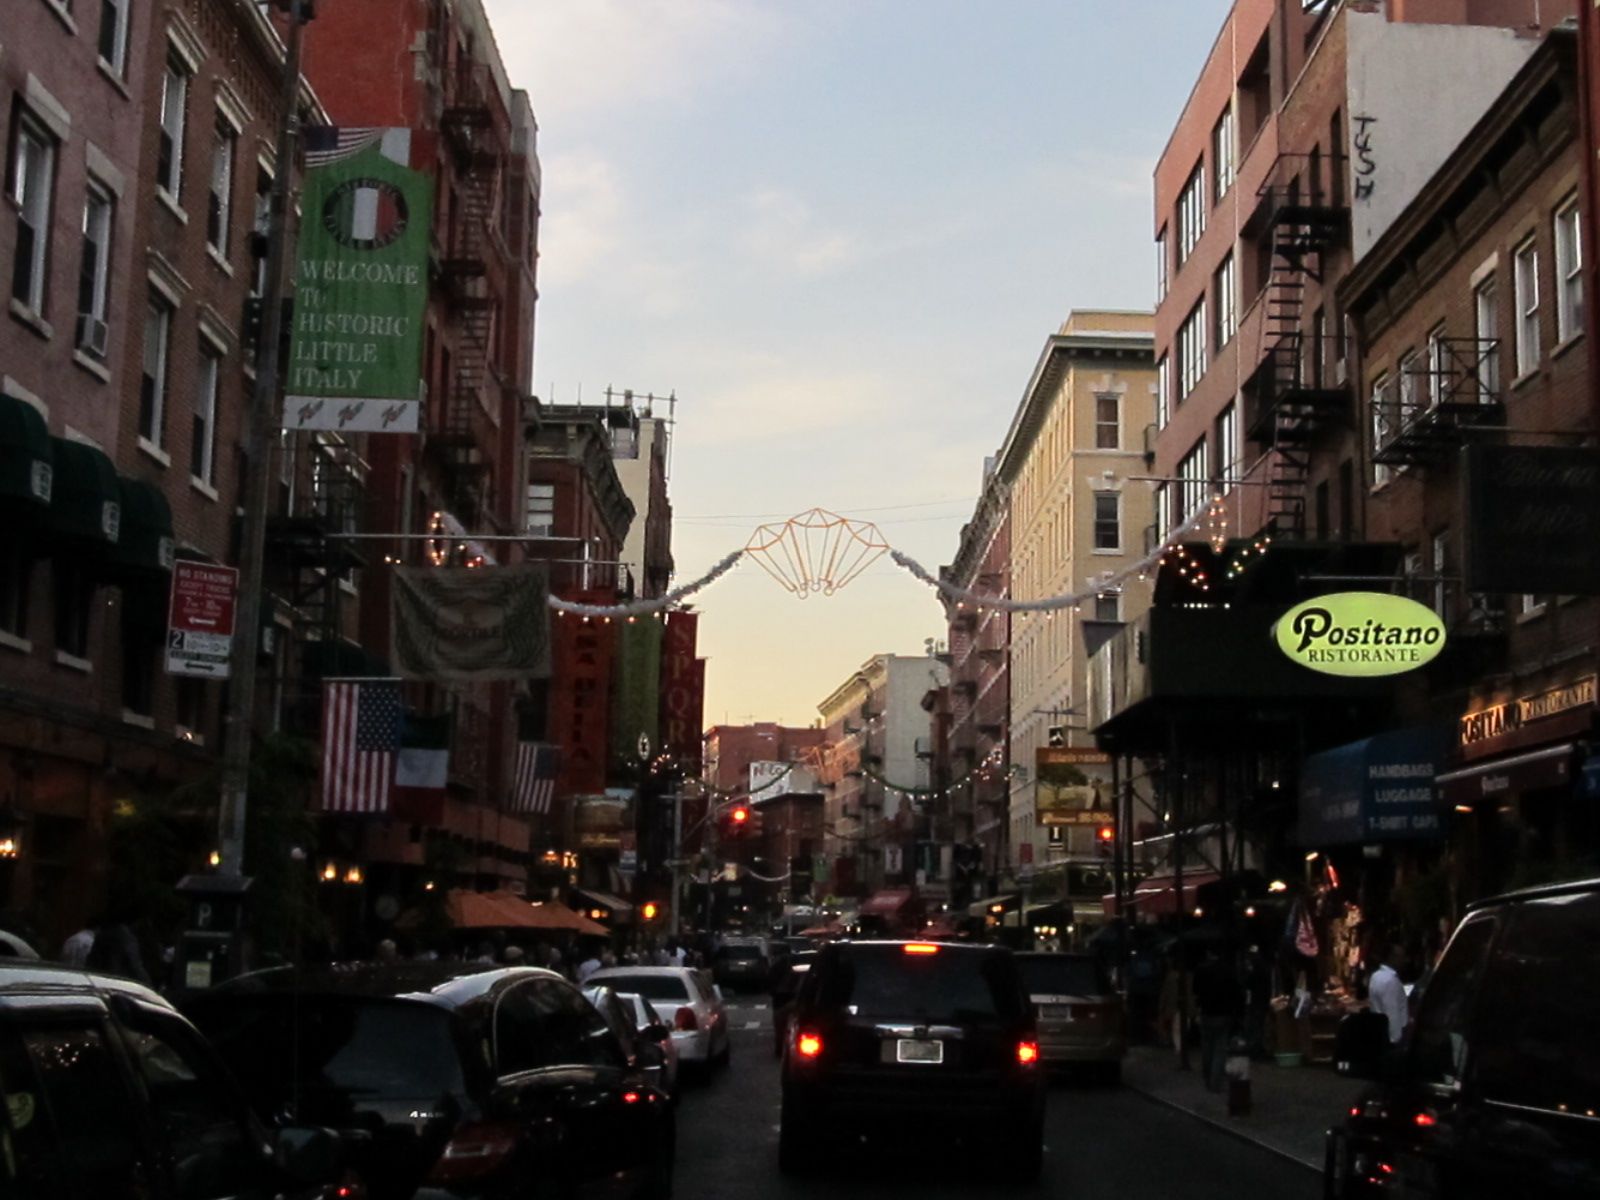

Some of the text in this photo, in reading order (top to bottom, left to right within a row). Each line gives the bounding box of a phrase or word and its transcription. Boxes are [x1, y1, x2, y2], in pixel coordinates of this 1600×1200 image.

[302, 260, 419, 285] WELCOME
[300, 312, 409, 336] HISTORIC
[296, 341, 378, 362] LITTLE
[294, 368, 362, 389] ITALY
[1293, 607, 1439, 653] Positano
[1308, 649, 1420, 662] RISTORANTE
[1368, 763, 1434, 779] HANDBAGS
[1375, 787, 1432, 803] LUGGAGE
